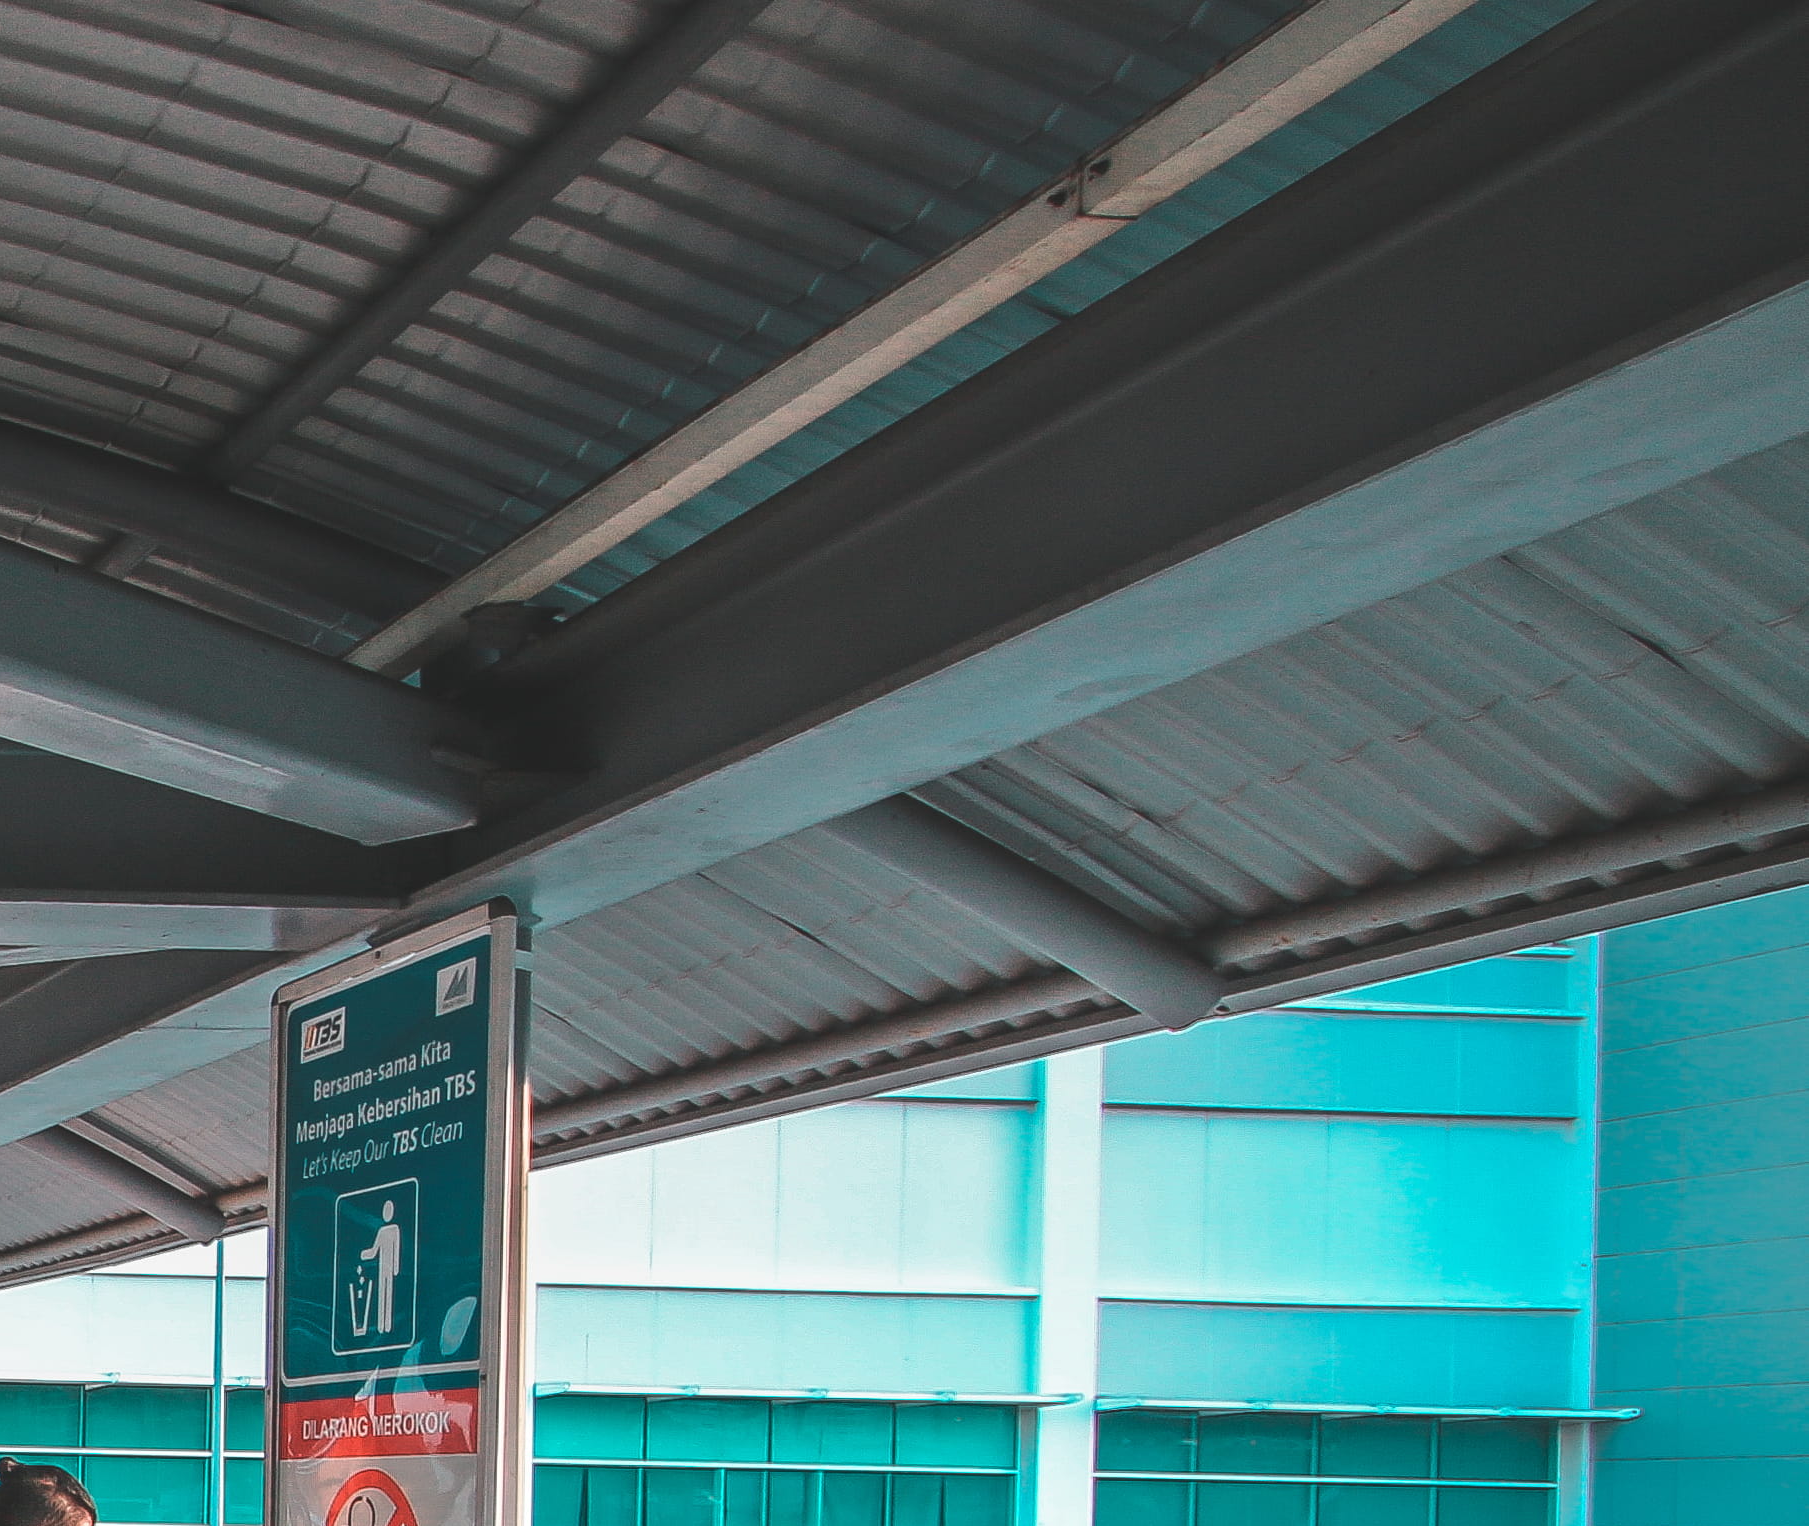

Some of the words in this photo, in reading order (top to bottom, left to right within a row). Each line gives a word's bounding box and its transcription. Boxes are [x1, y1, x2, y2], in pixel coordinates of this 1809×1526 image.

[313, 1050, 416, 1102] Bersama-sama
[420, 1040, 451, 1066] Kita
[296, 1112, 354, 1144] Menjaga
[357, 1084, 440, 1125] Kebersihan
[445, 1070, 476, 1101] TBS
[303, 1152, 327, 1179] Let's
[330, 1148, 361, 1173] Keep
[364, 1140, 388, 1161] Our
[392, 1127, 417, 1155] TBS
[421, 1119, 463, 1148] Clean
[302, 1416, 369, 1440] DILARANG
[372, 1411, 450, 1437] MEROKOK
